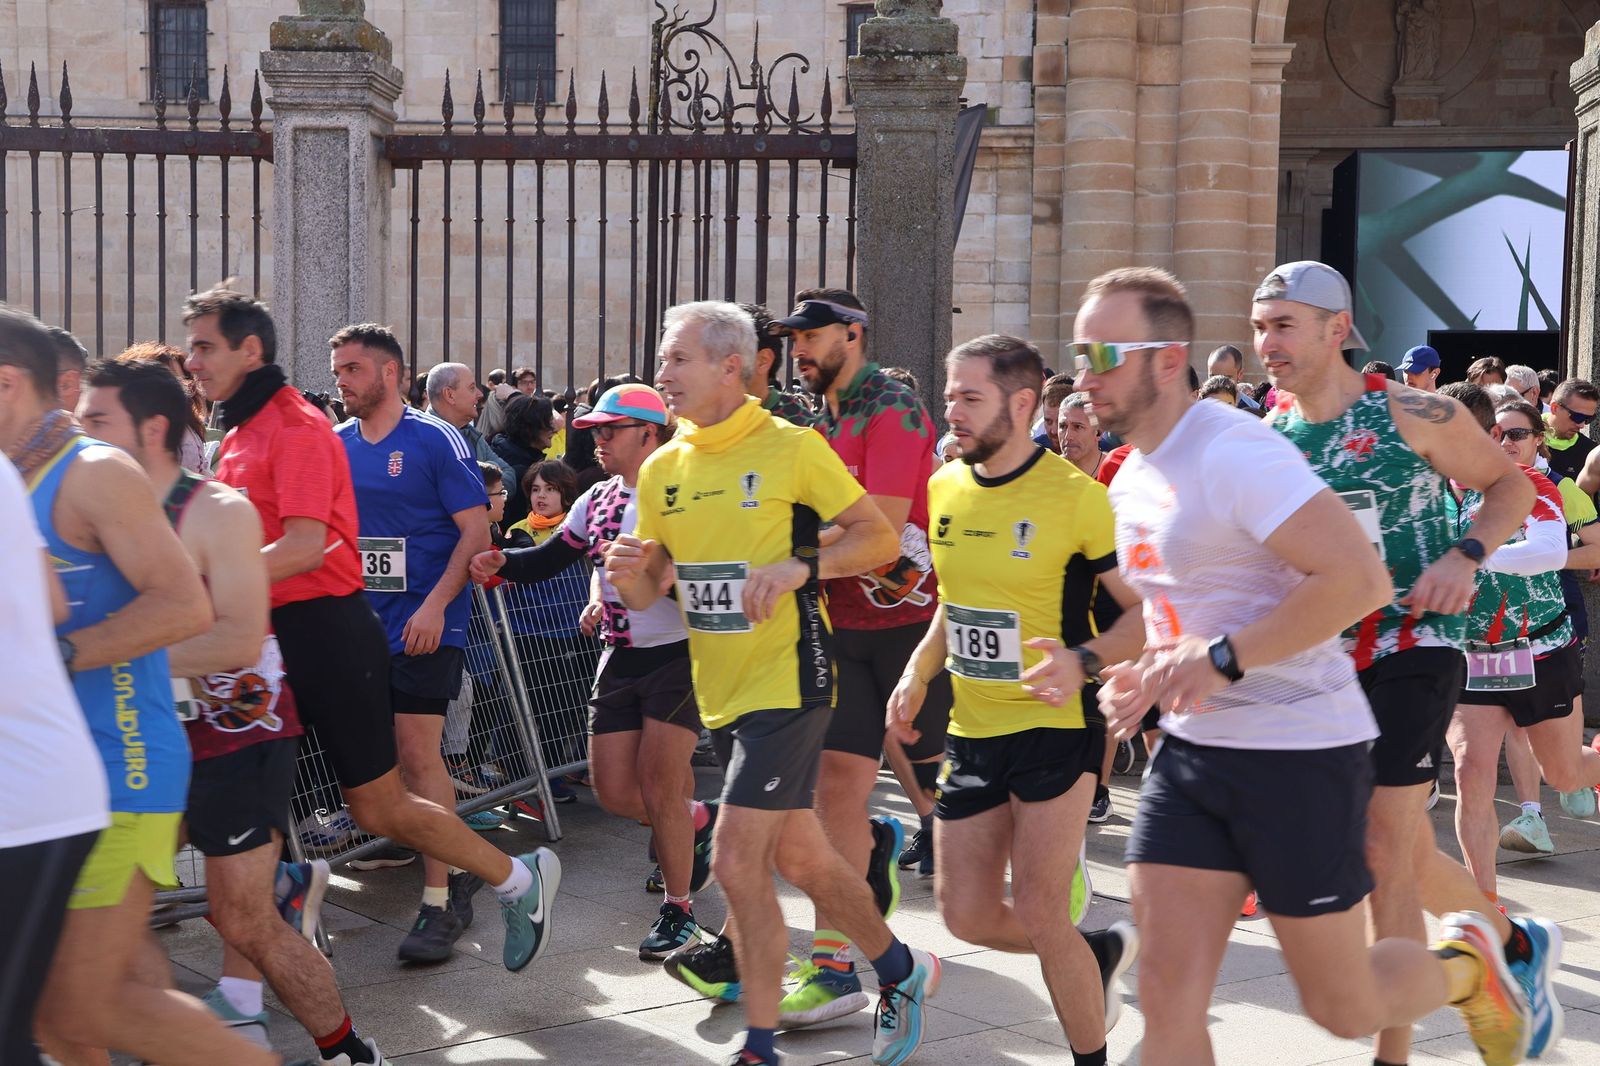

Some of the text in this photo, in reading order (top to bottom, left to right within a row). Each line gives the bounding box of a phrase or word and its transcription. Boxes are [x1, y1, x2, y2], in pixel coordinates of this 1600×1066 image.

[687, 582, 734, 611] 344
[954, 625, 1000, 659] 189
[1476, 651, 1517, 675] 771
